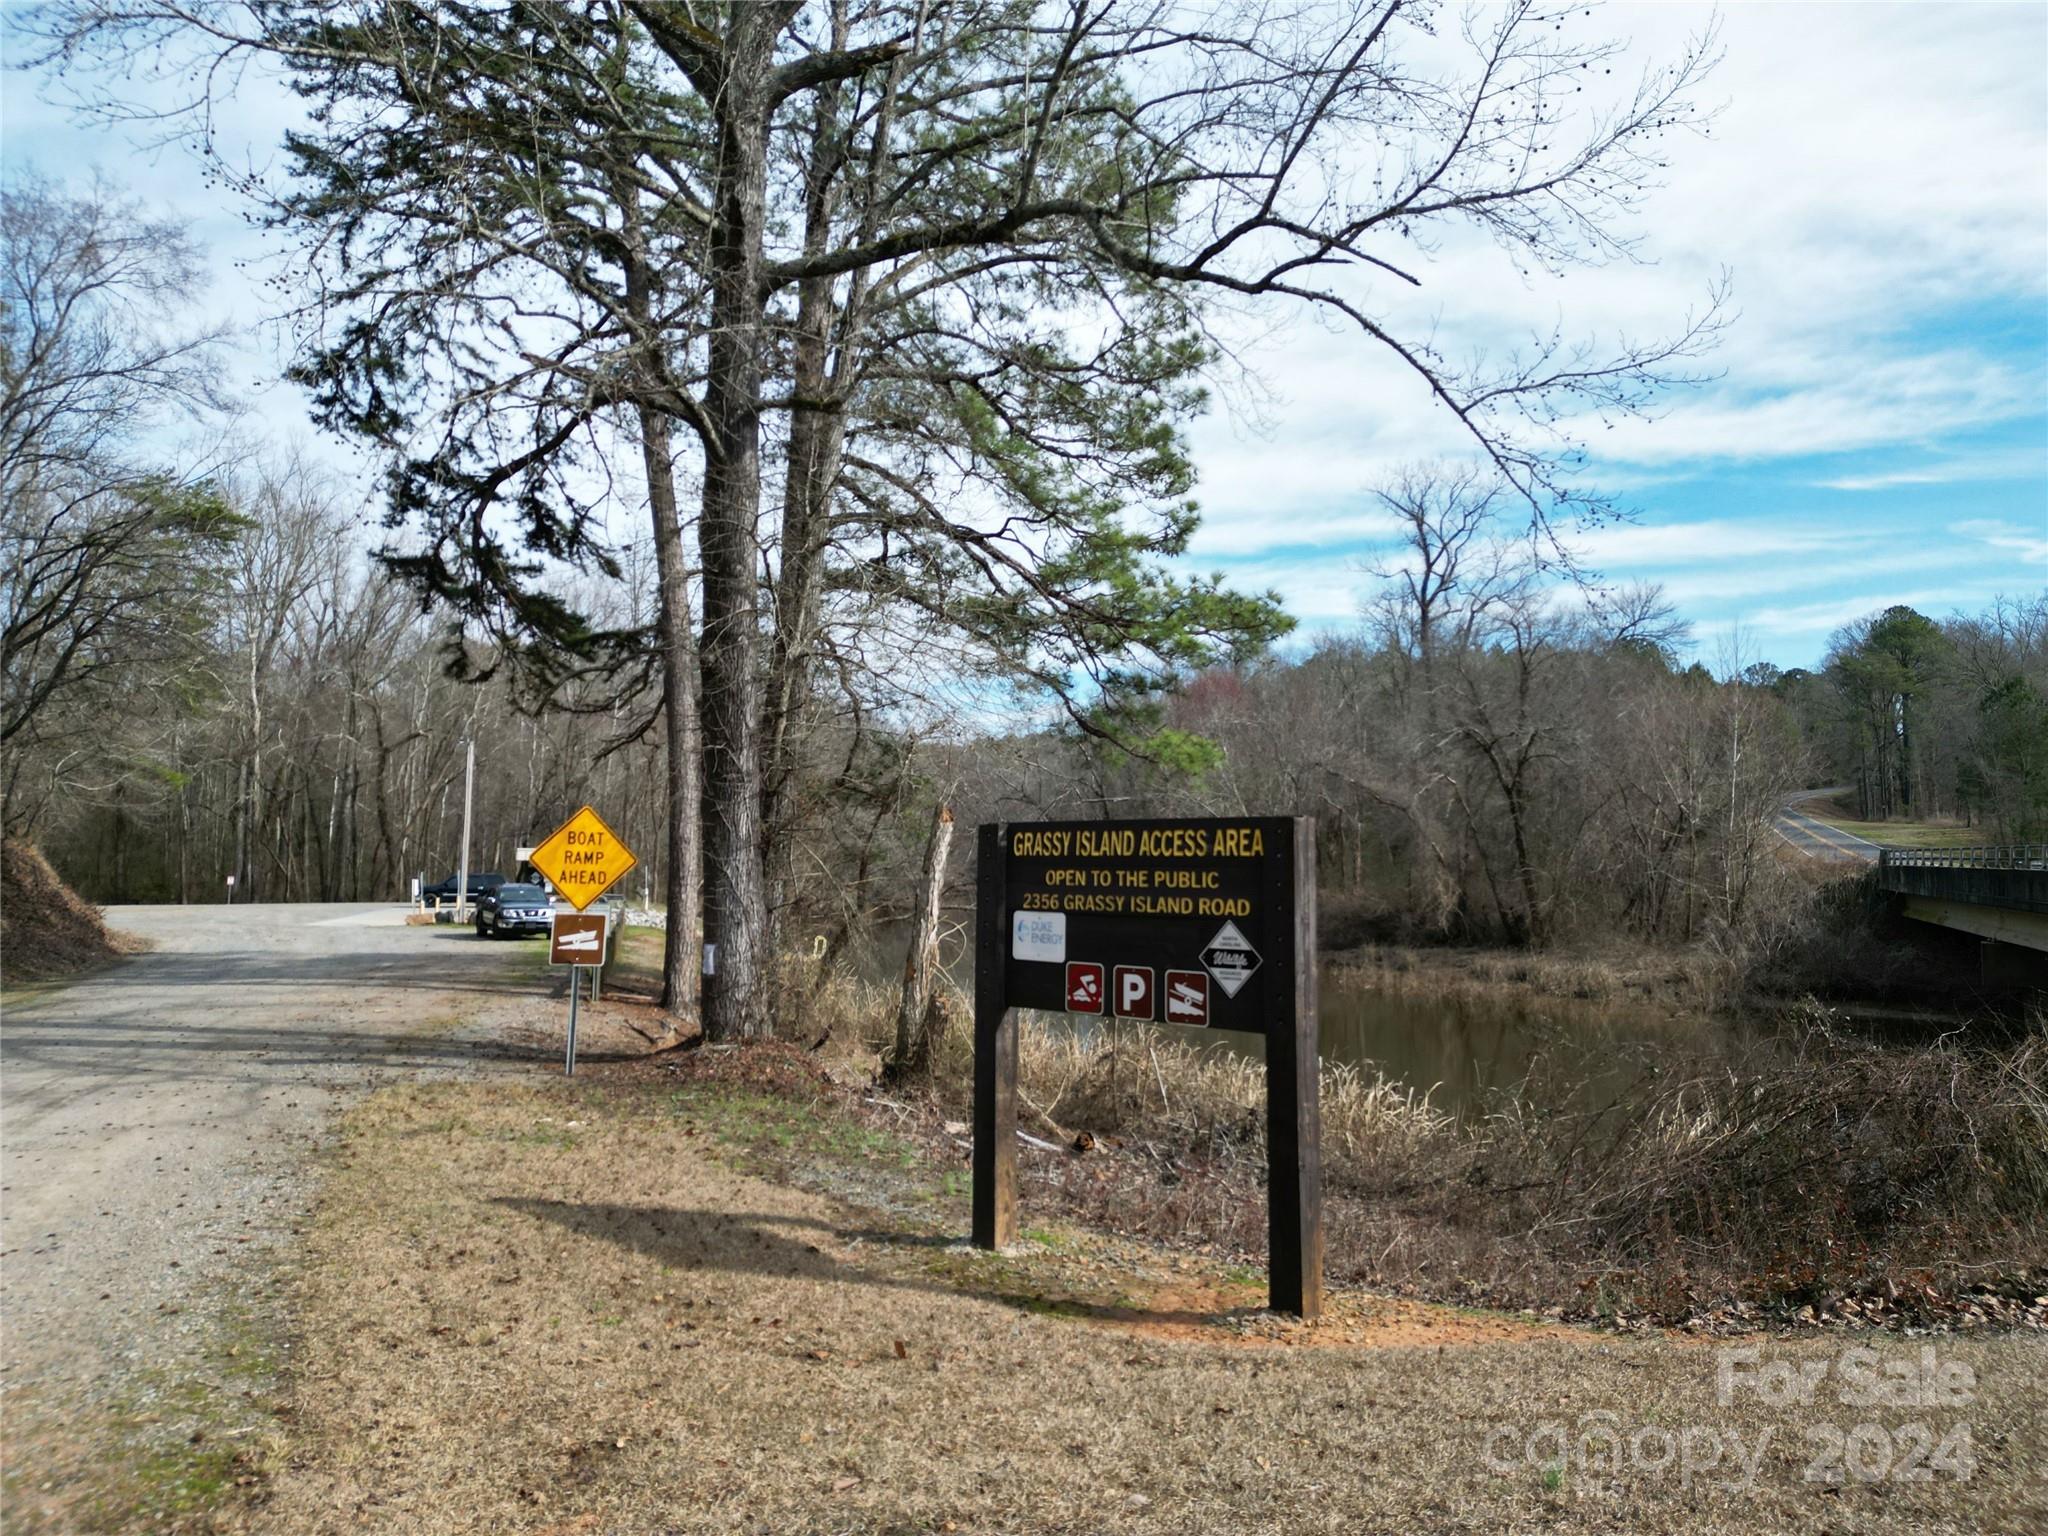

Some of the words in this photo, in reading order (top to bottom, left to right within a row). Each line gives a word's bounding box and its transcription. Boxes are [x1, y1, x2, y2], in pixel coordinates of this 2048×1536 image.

[567, 831, 604, 845] BOAT
[1013, 831, 1072, 857] GRASSY
[1075, 830, 1135, 857] ISLAND
[1139, 829, 1208, 857] ACCESS
[1213, 828, 1264, 857] AREA
[564, 850, 604, 865] RAMP
[558, 870, 607, 885] AHEAD
[1045, 870, 1086, 886] OPEN
[1091, 870, 1111, 887] TO
[1116, 870, 1149, 888] THE
[1154, 870, 1220, 889] PUBLIC
[1022, 893, 1059, 910] 2356
[1063, 894, 1126, 912] GRASSY
[1130, 896, 1193, 915] ISLAND
[1198, 898, 1251, 917] ROAD
[1122, 973, 1146, 1011] P
